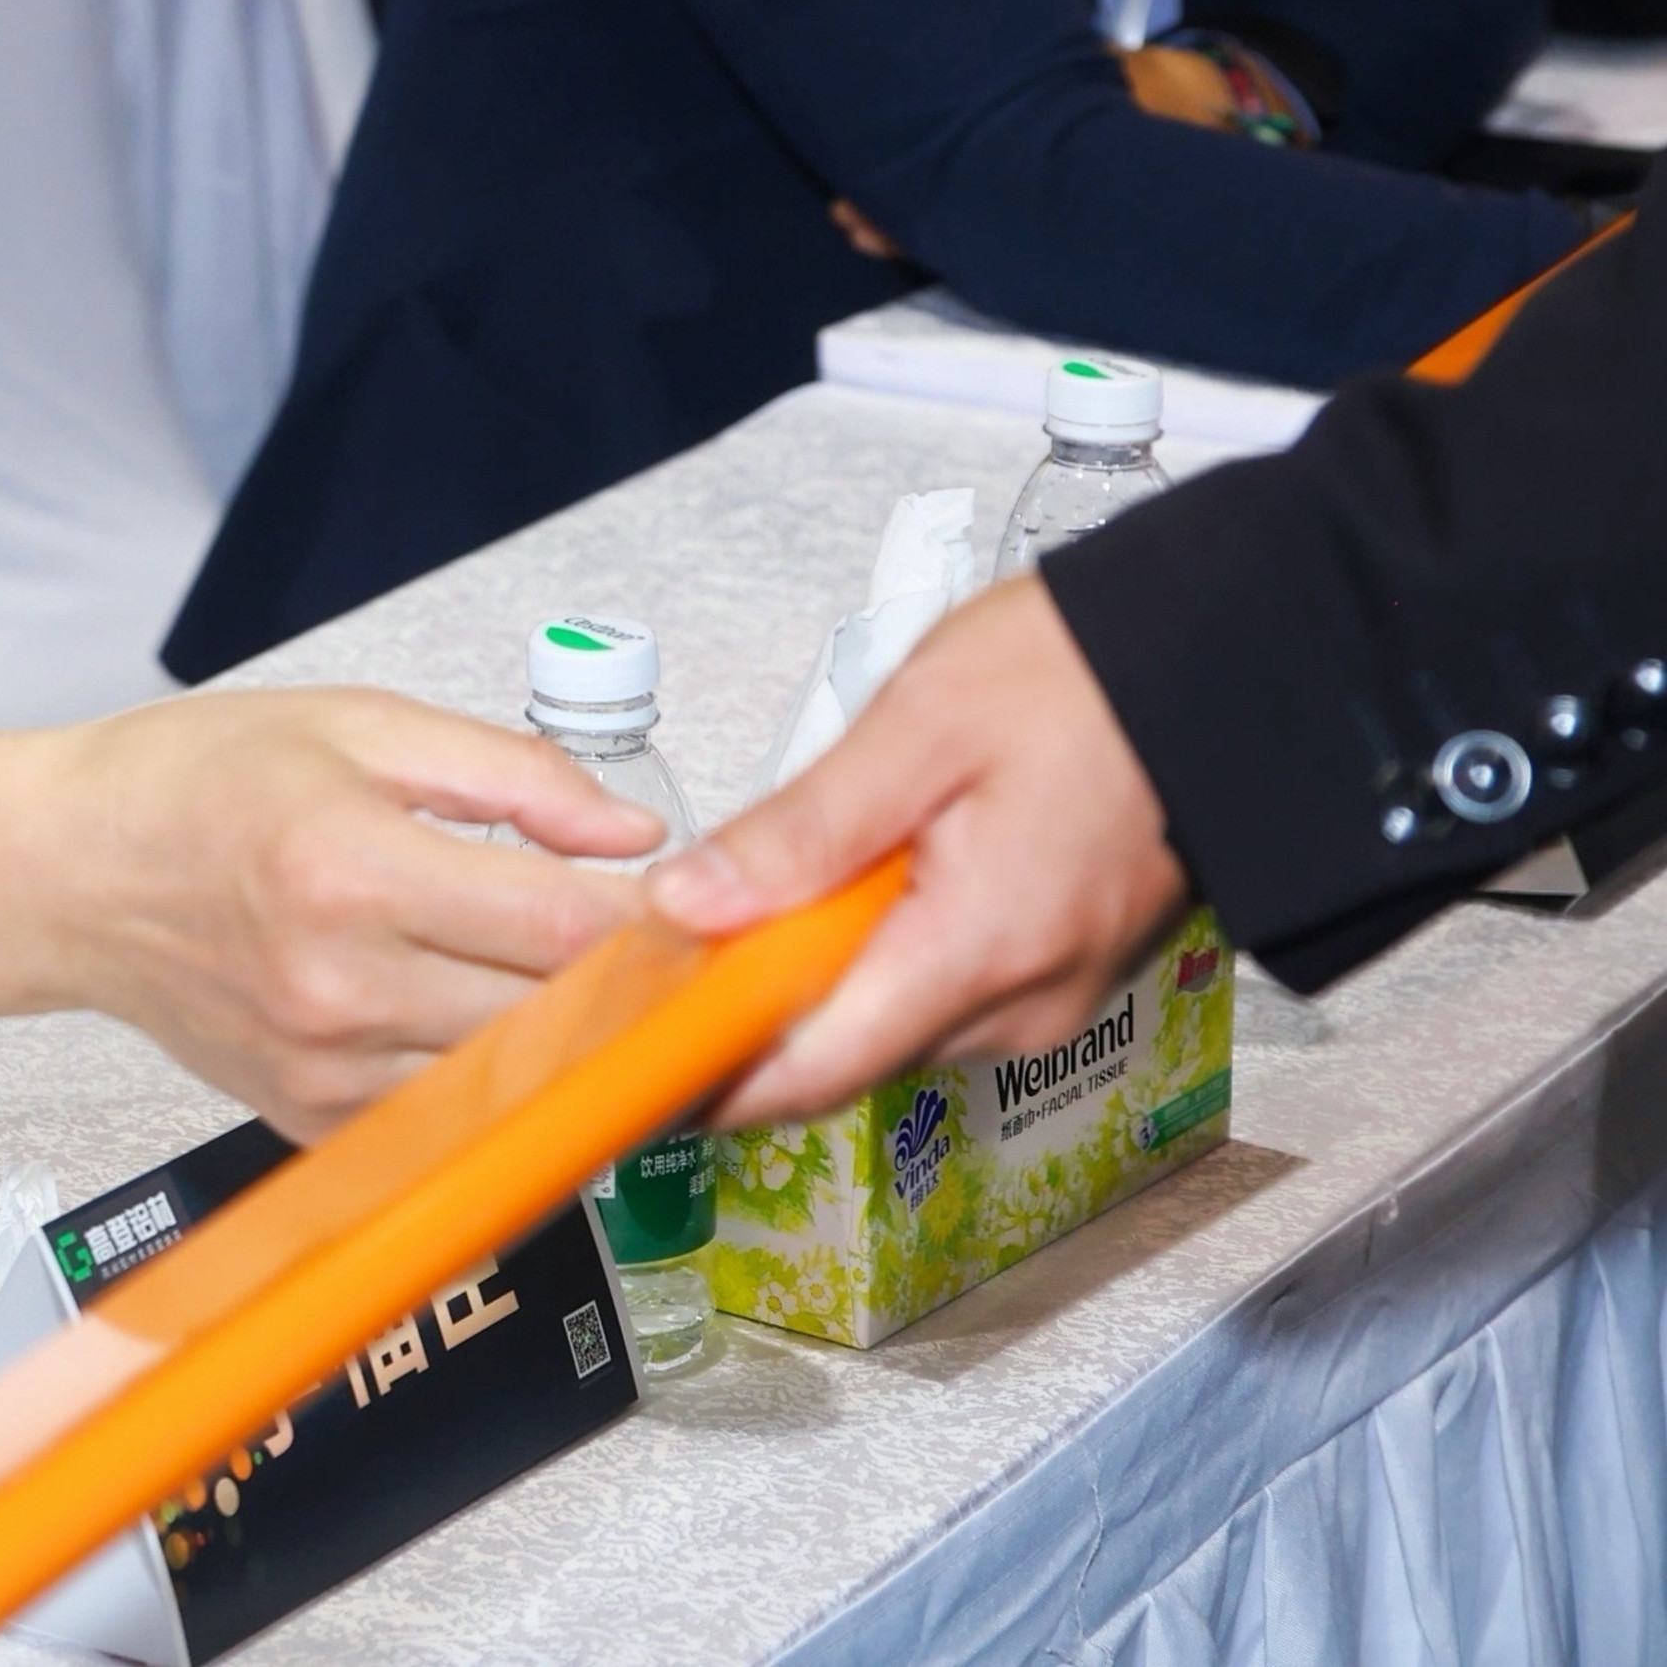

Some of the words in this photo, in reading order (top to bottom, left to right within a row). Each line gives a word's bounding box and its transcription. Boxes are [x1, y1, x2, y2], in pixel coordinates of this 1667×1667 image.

[1041, 1082, 1084, 1120] FACIAL
[1087, 1056, 1128, 1093] TISSUE
[640, 1146, 697, 1178] 饮用纯净水
